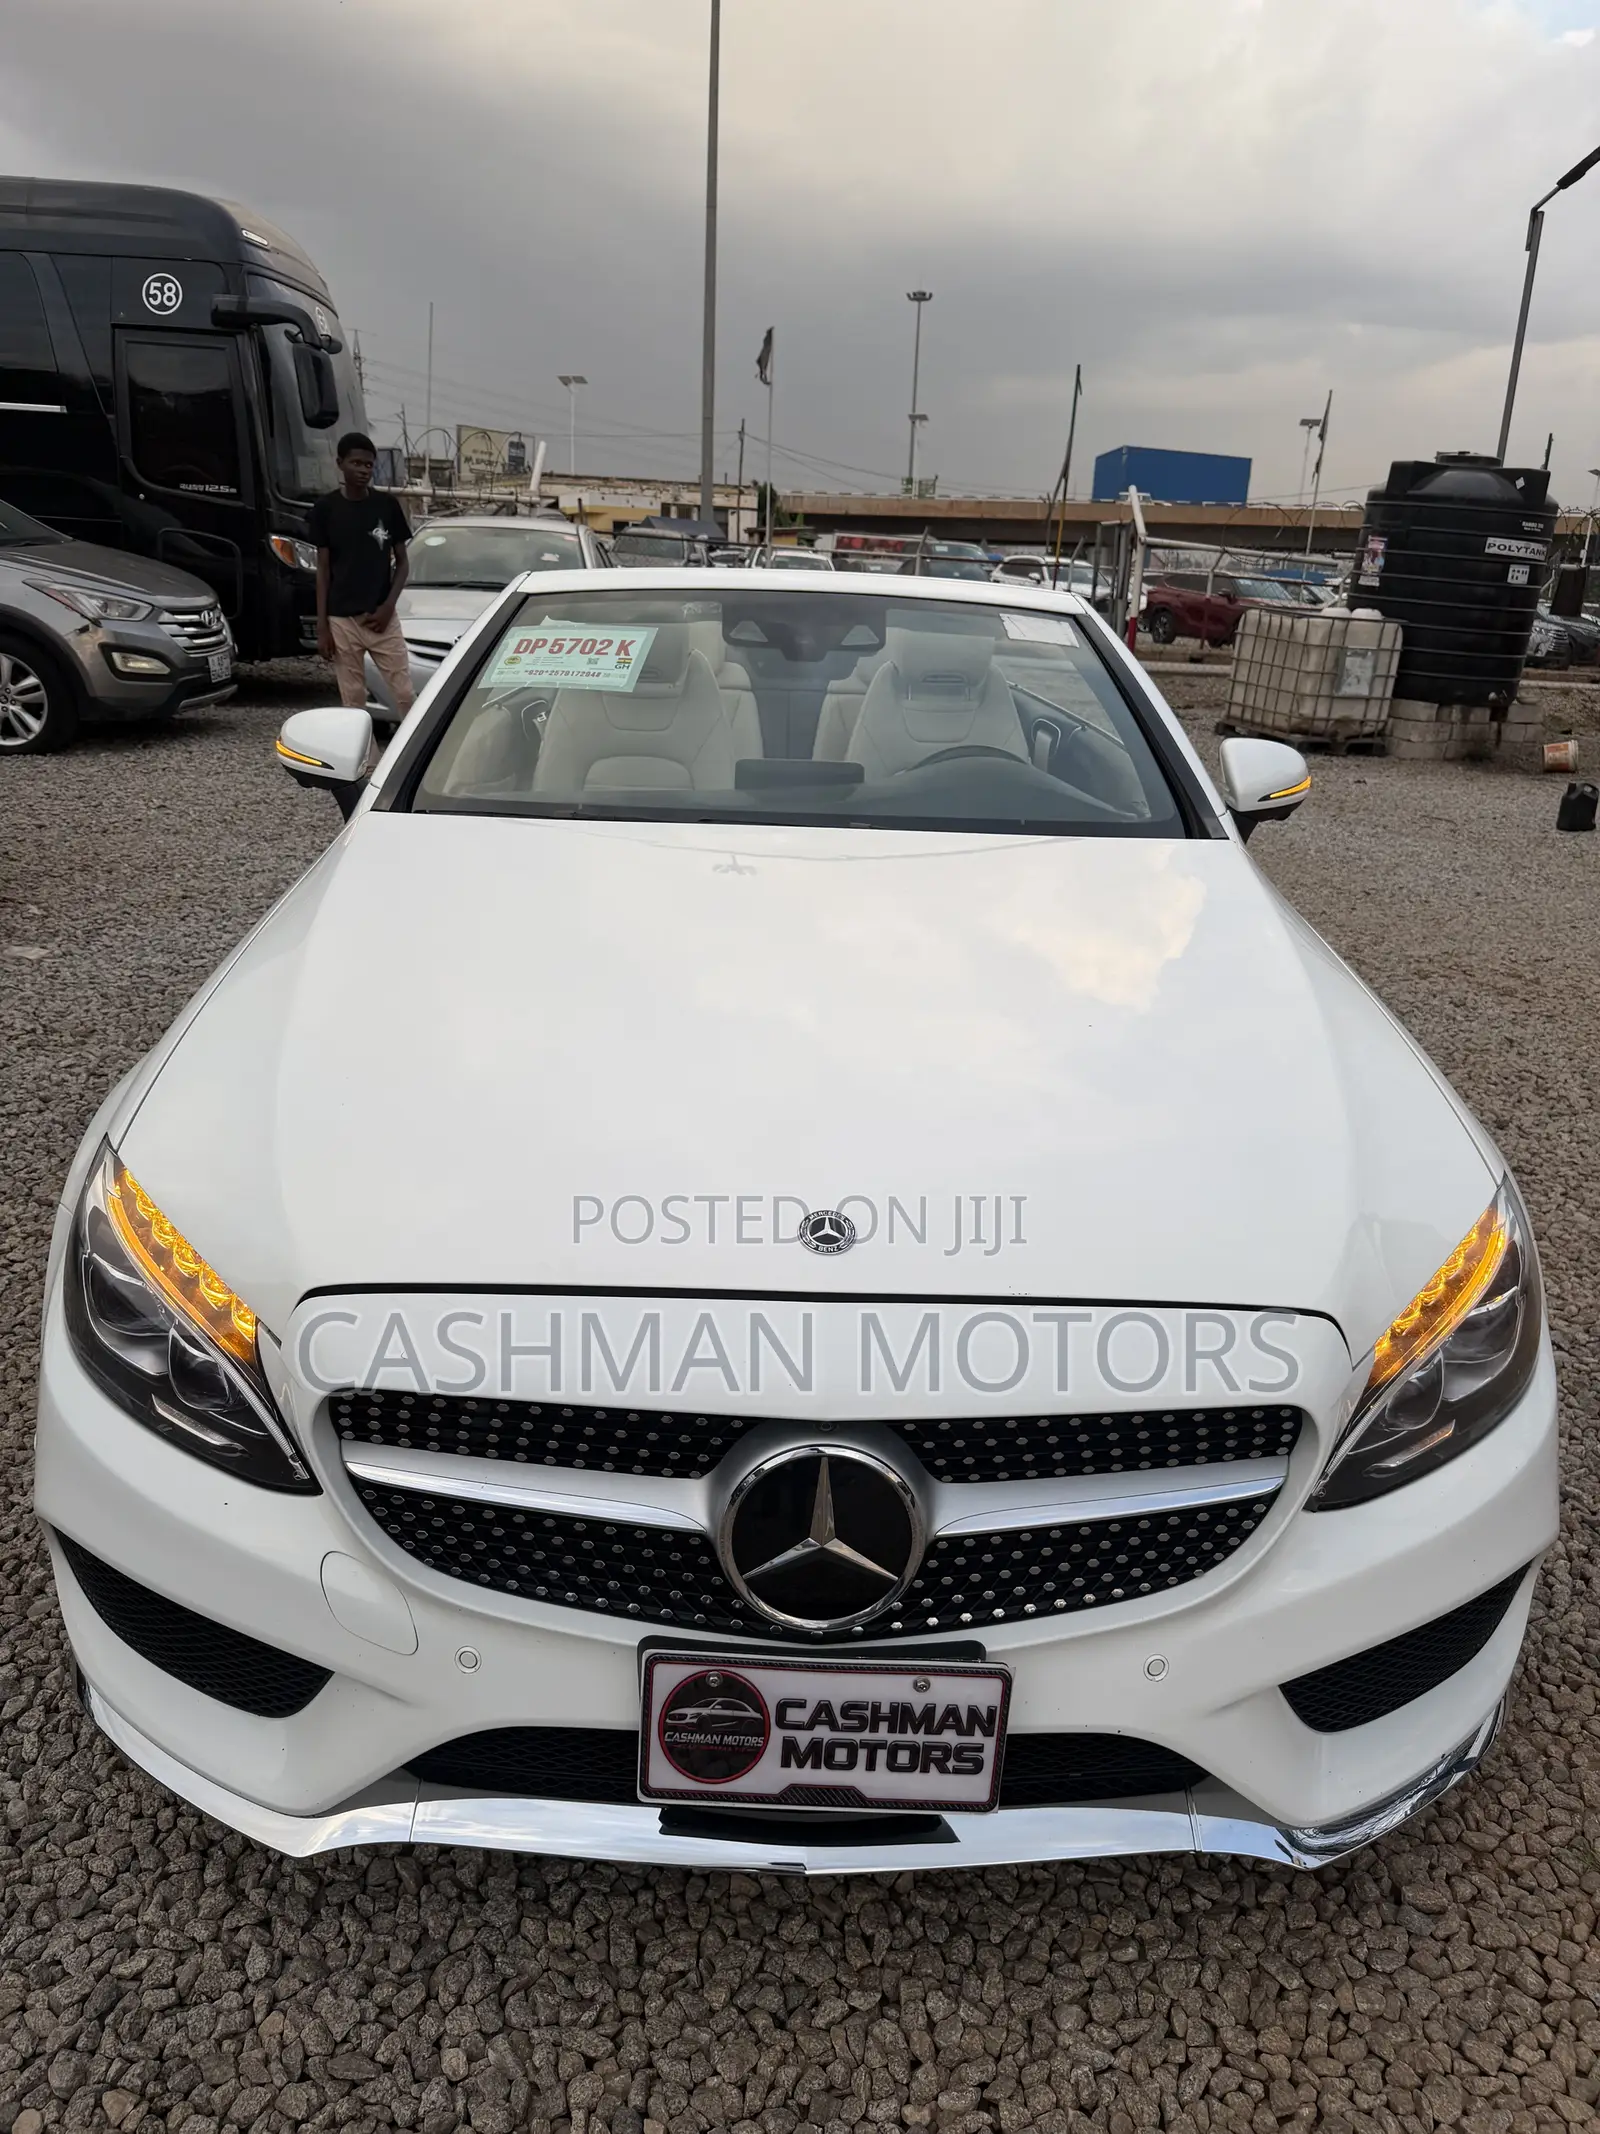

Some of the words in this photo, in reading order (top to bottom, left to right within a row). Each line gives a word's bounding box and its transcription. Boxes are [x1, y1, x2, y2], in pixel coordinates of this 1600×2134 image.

[149, 282, 177, 306] 58
[1487, 542, 1546, 556] POLYTANK
[513, 638, 548, 655] DP
[548, 638, 614, 656] 5702
[615, 640, 636, 657] K
[775, 1698, 998, 1738] CASHMAN
[664, 1731, 722, 1745] CASHMAN
[722, 1734, 765, 1747] MOTORS
[780, 1735, 985, 1775] MOTORS
